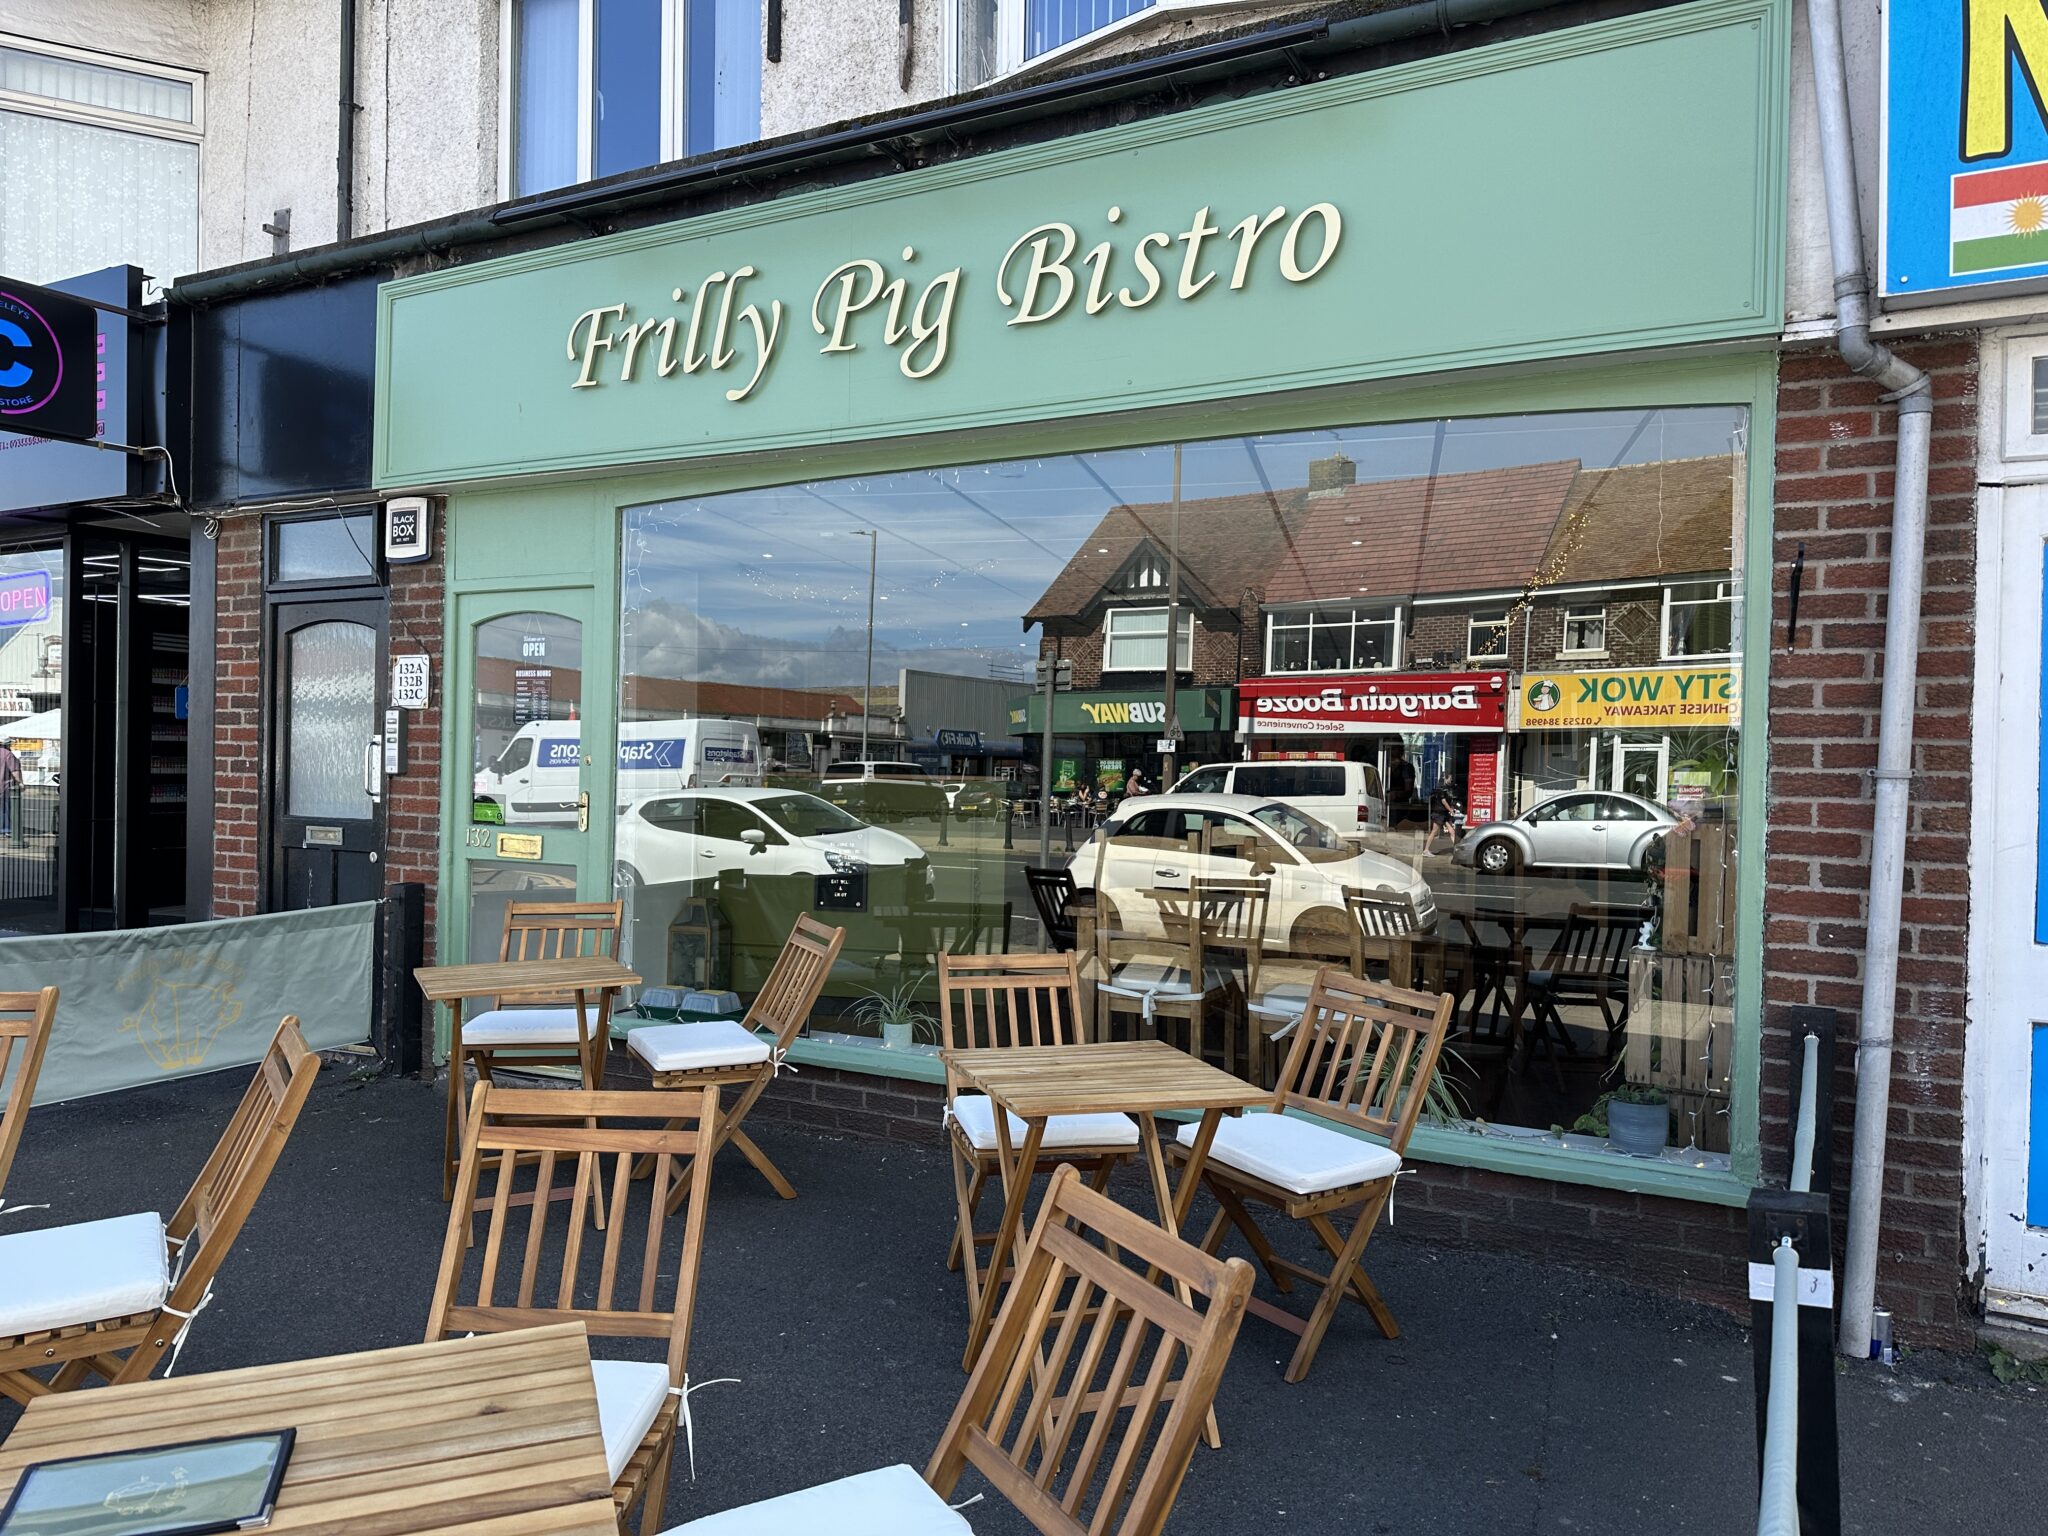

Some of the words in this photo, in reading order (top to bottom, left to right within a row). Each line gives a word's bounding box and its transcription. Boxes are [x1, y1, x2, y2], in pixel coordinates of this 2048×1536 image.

[566, 265, 784, 402] Frilly
[810, 245, 962, 380] Pig
[996, 202, 1342, 327] Bistro
[393, 515, 415, 524] BLACK
[393, 524, 415, 537] BOX
[0, 586, 47, 612] OPEN
[522, 642, 546, 657] OPEN
[399, 663, 423, 674] 132A
[399, 675, 423, 687] 132B
[398, 688, 423, 700] 132C
[466, 828, 491, 848] 132
